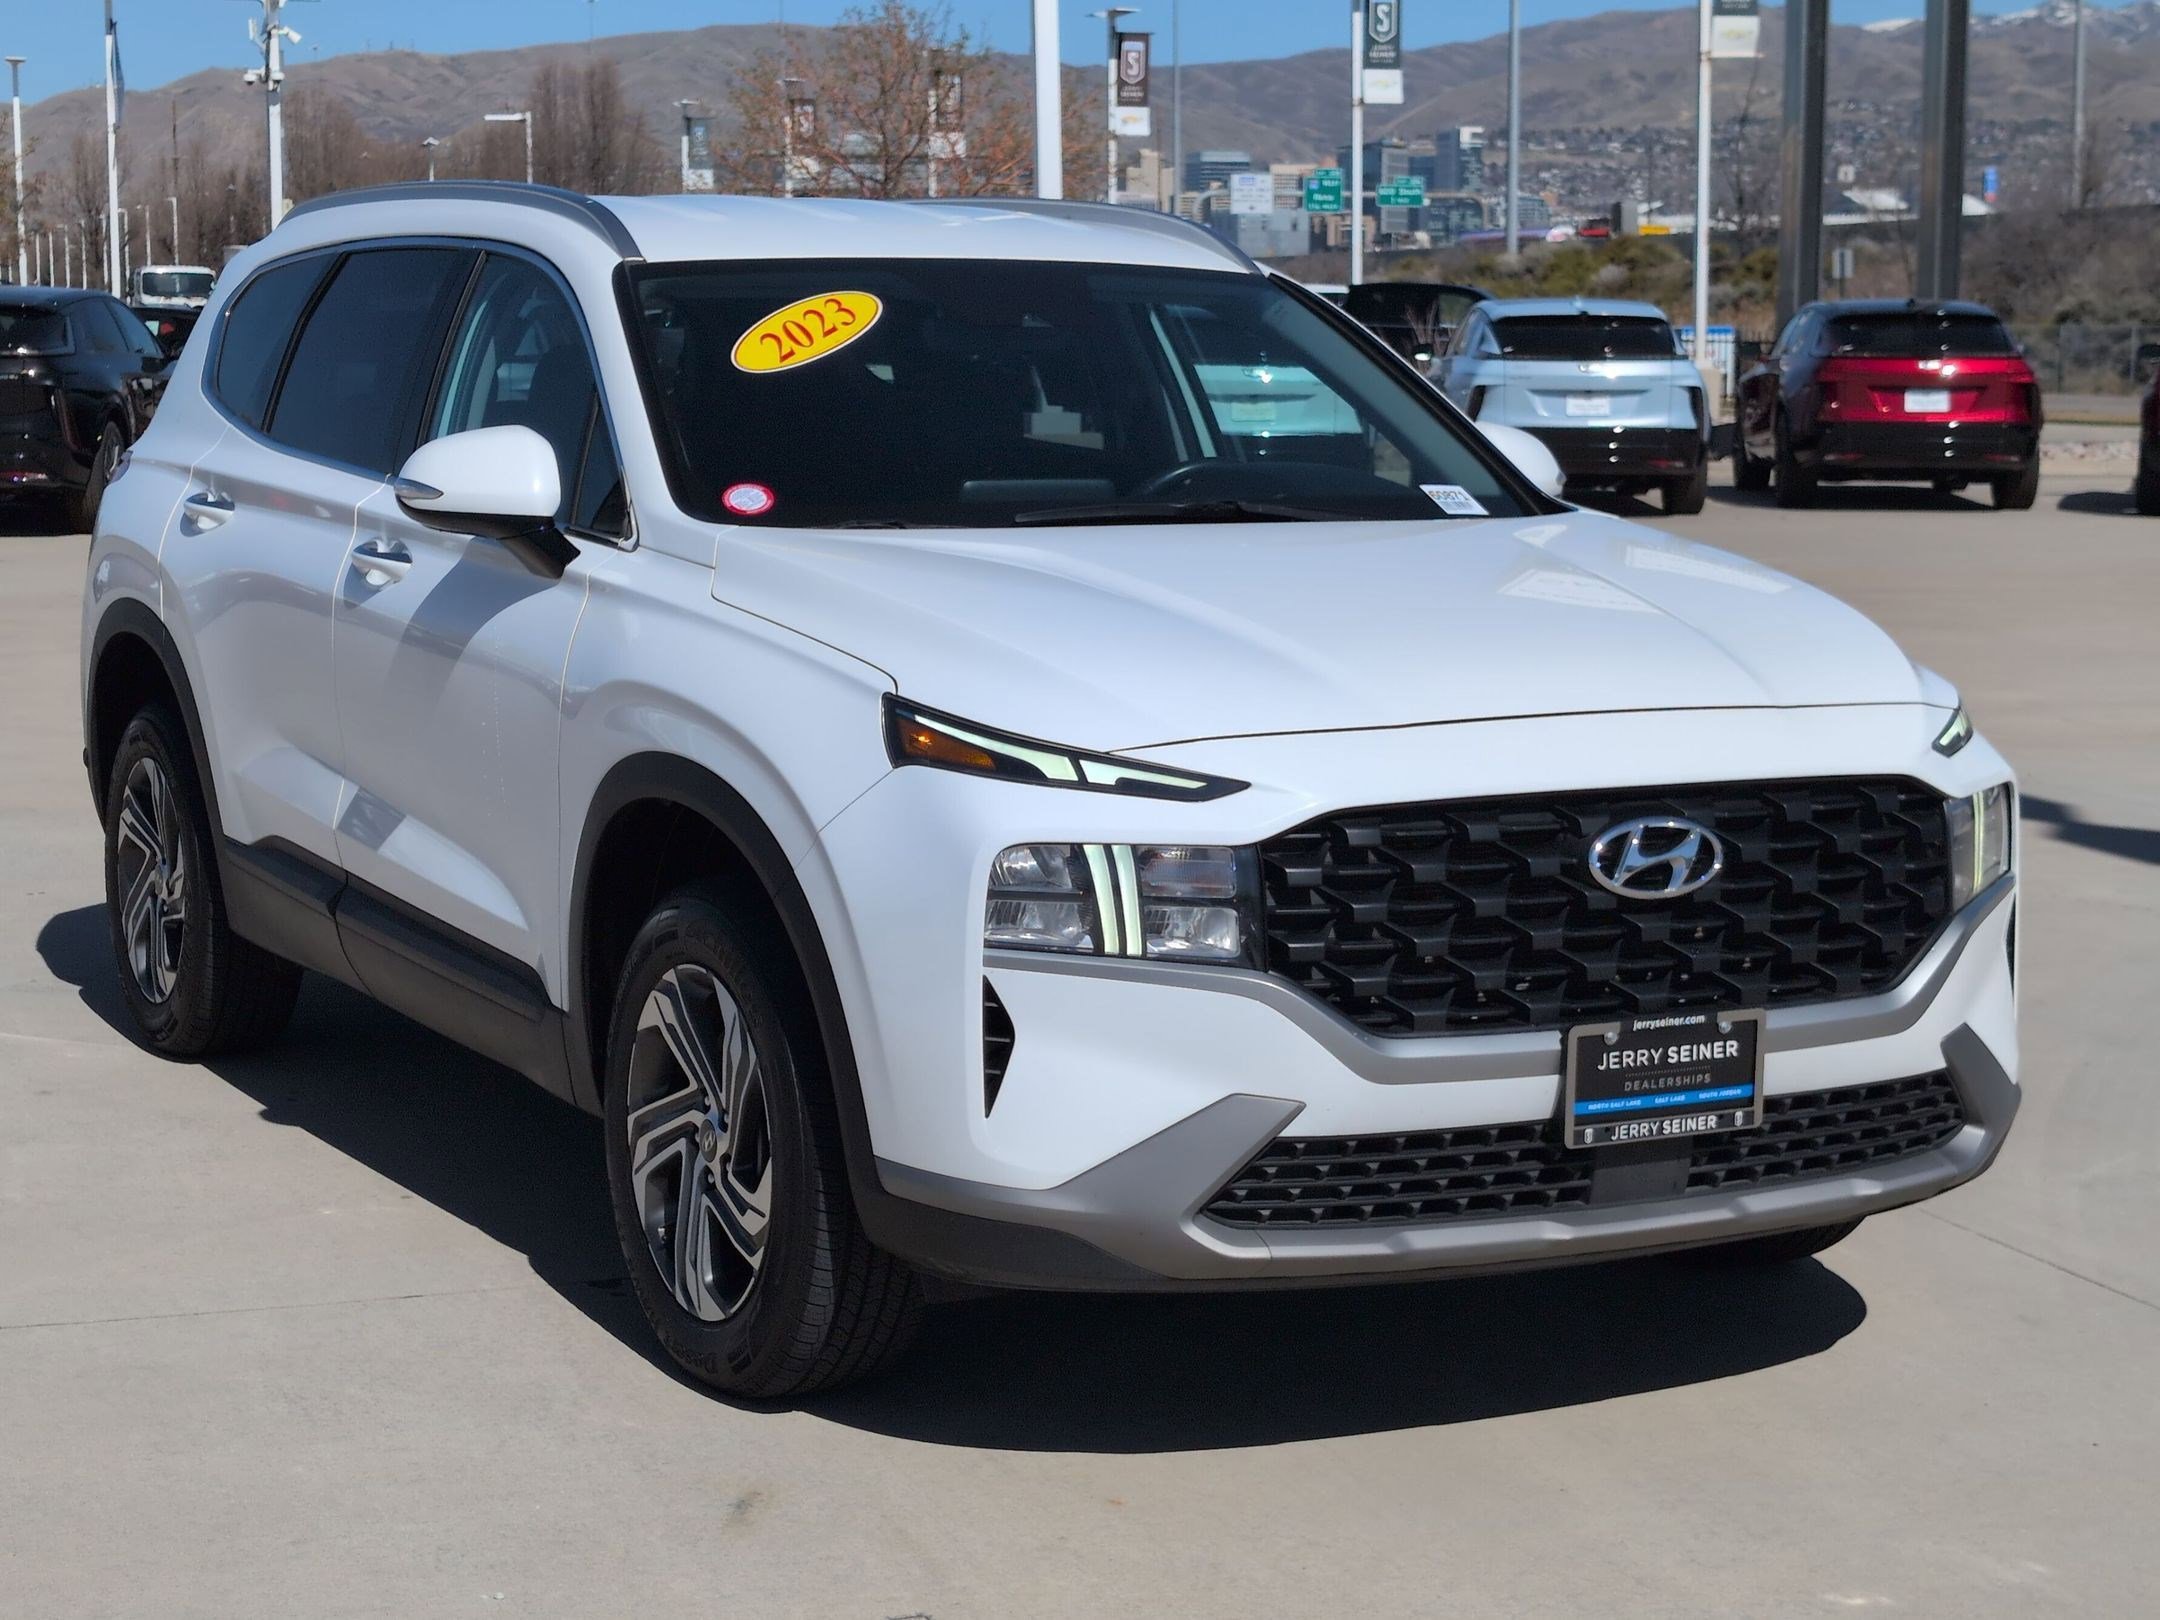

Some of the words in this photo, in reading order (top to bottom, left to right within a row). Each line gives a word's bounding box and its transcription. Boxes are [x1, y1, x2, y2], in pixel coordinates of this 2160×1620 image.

[1376, 3, 1390, 32] S
[759, 298, 856, 364] 2023
[1632, 1014, 1706, 1032] jerryseiner.com
[1597, 1047, 1663, 1071] JERRY
[1667, 1039, 1739, 1064] SEINER
[1624, 1072, 1712, 1092] DEALERSHIPS
[1611, 1121, 1660, 1141] JERRY
[1662, 1115, 1718, 1135] SEINER
